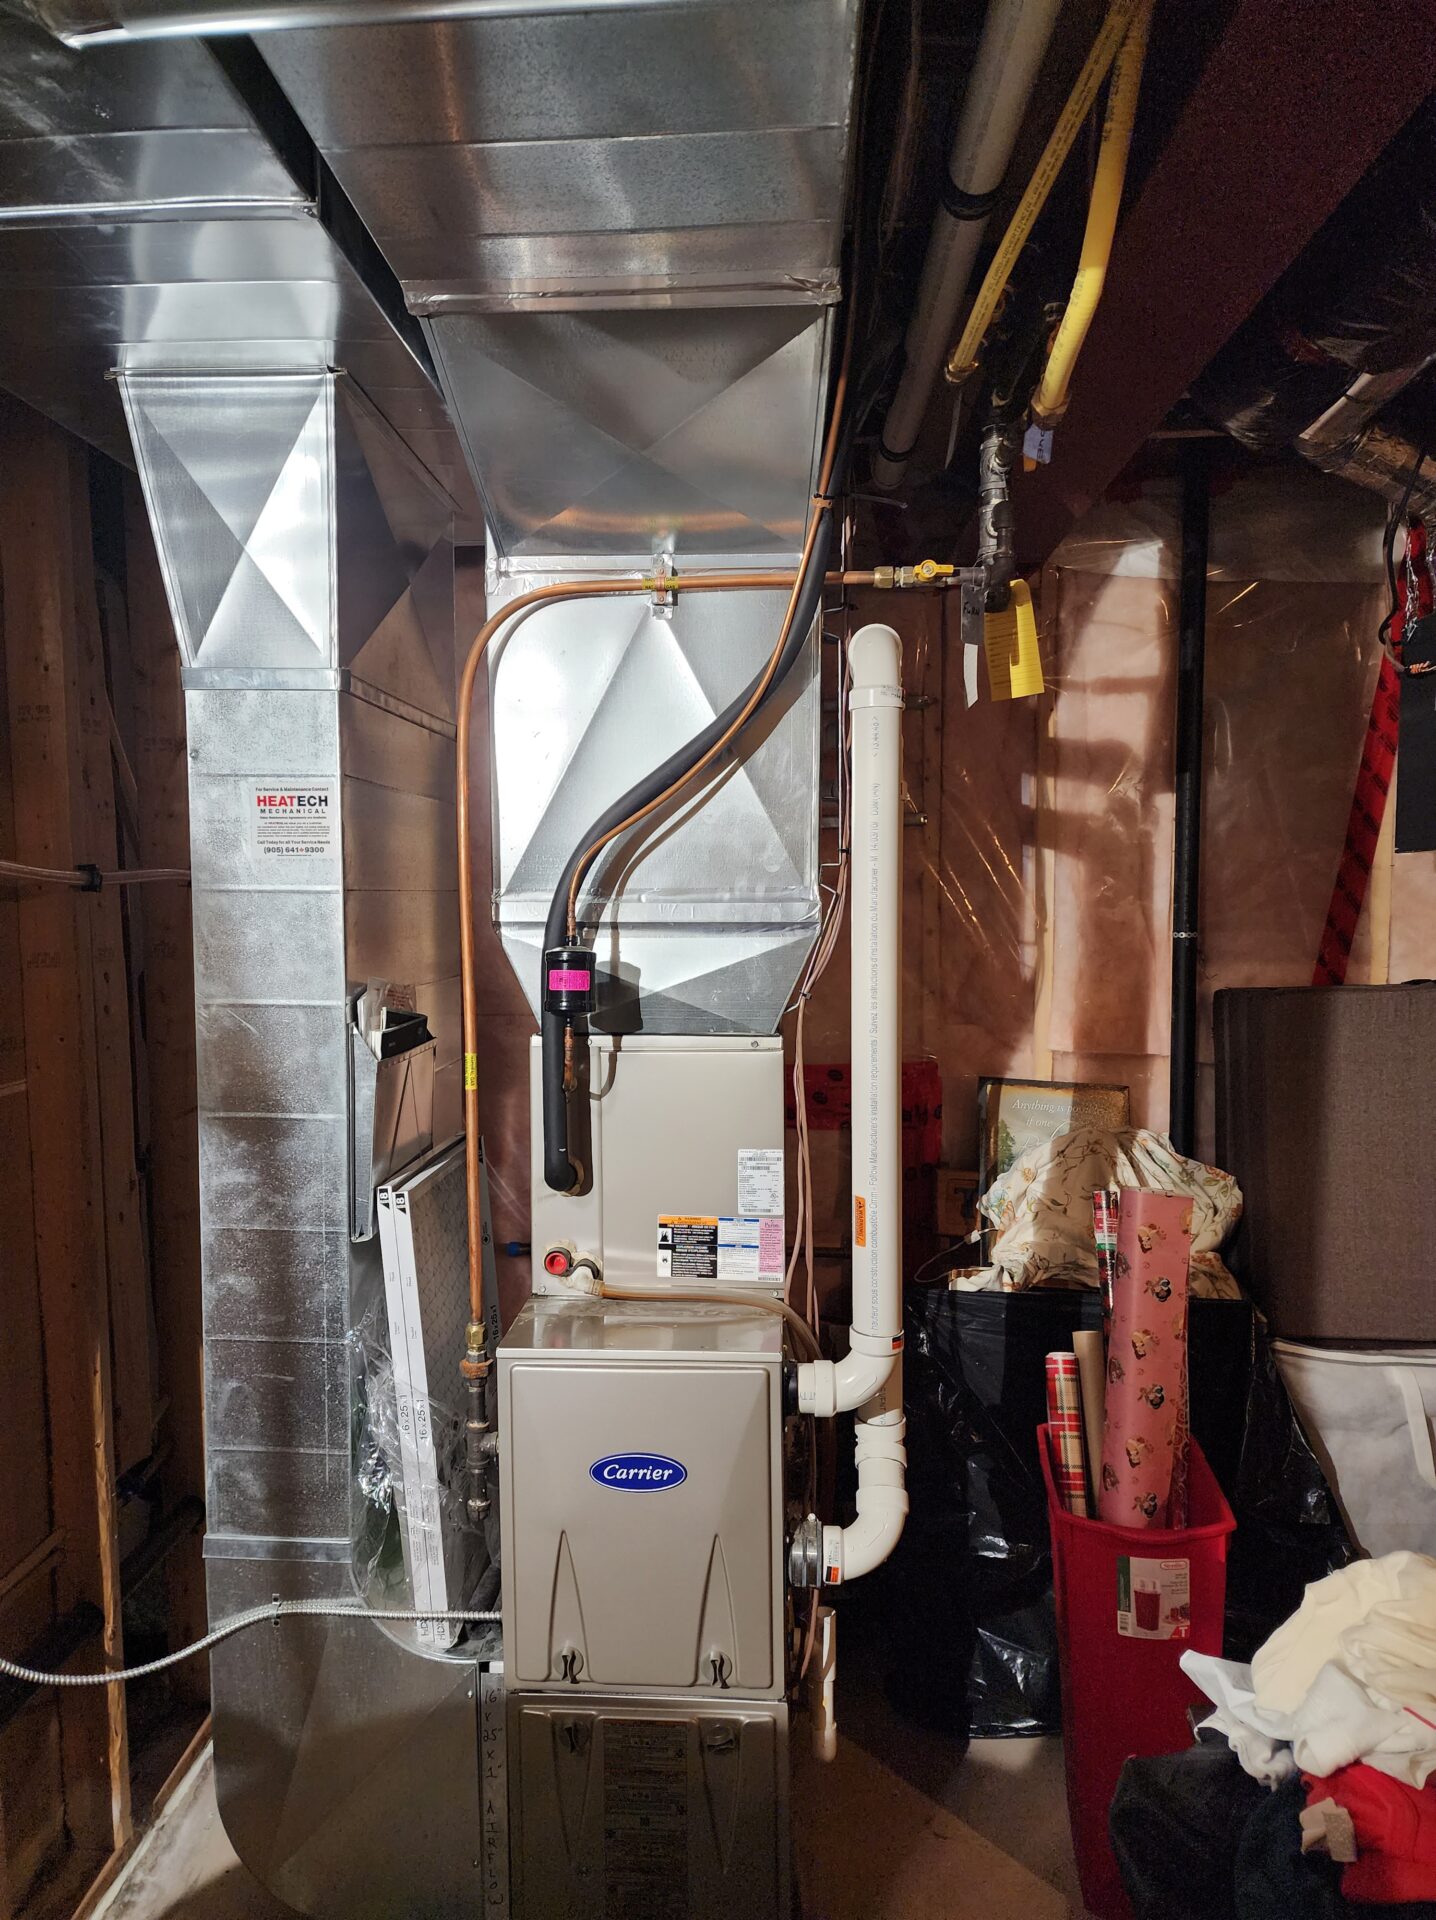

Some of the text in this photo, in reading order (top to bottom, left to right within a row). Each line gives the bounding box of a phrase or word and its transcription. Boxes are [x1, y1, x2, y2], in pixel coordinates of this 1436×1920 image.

[256, 795, 328, 807] HEATECH
[264, 846, 284, 854] (905)
[1011, 1099, 1056, 1113] Anything
[1057, 1104, 1065, 1112] is
[1026, 1116, 1034, 1128] if
[603, 1464, 673, 1480] Carrier
